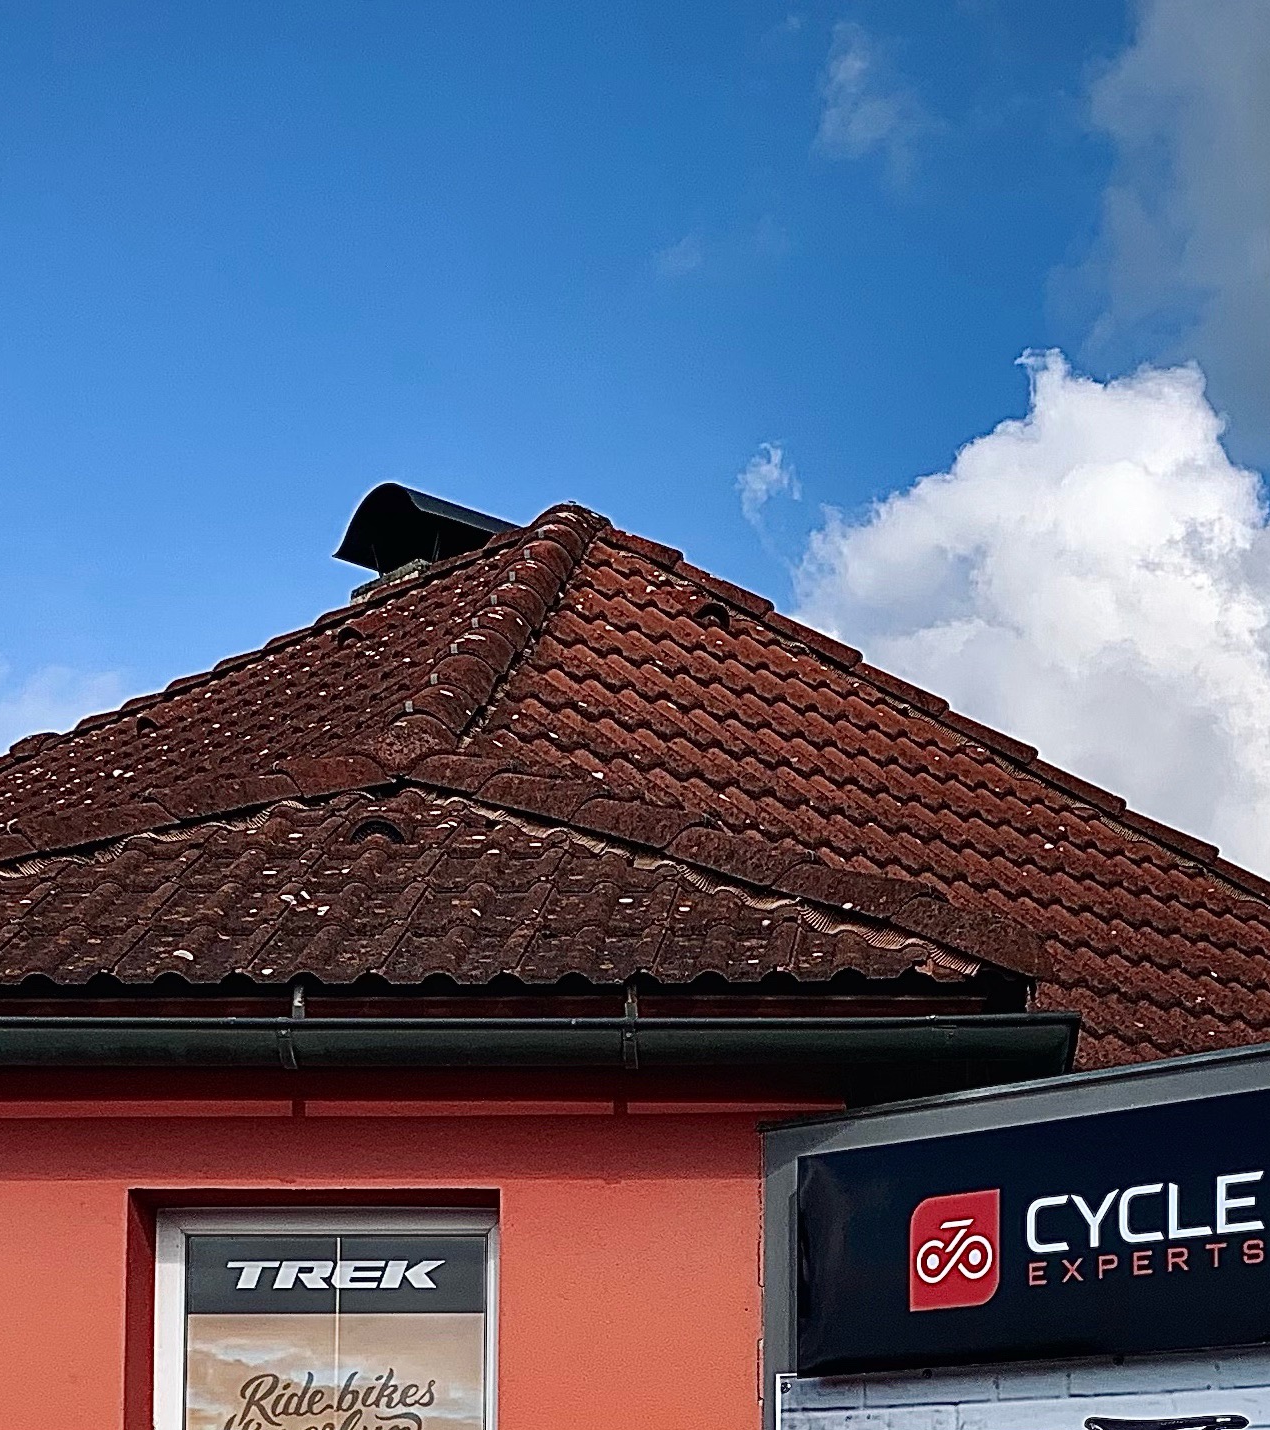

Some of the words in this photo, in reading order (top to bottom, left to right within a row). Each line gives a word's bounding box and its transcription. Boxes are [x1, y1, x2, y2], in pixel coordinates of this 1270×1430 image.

[1027, 1170, 1265, 1254] CYCLE
[227, 1260, 446, 1289] TREK
[1029, 1239, 1265, 1286] EXPERTS
[239, 1371, 334, 1426] Ride
[334, 1368, 436, 1413] bikes
